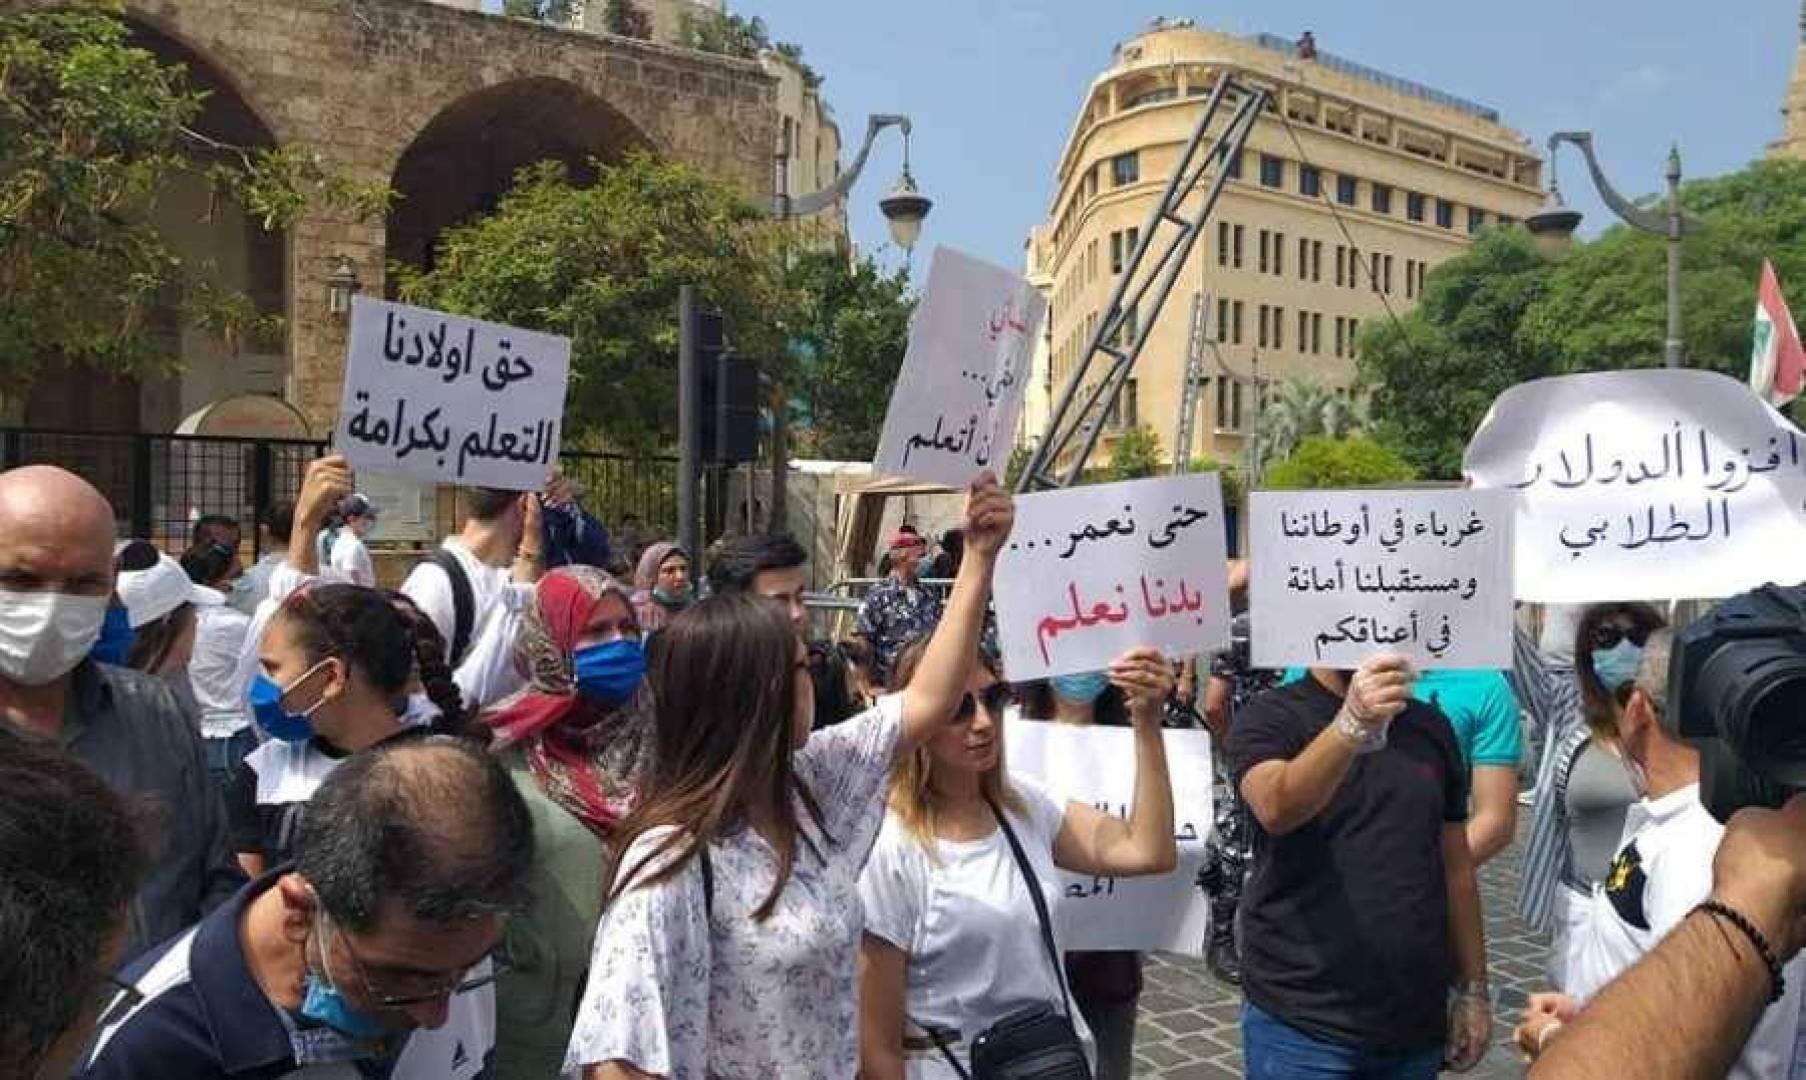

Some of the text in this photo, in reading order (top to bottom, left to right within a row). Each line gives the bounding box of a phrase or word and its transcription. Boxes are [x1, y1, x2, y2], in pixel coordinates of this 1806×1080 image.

[384, 311, 534, 391] حق اولادنا
[349, 391, 554, 477] التعلم بكرامة
[903, 415, 978, 467] أتعلم
[1148, 504, 1209, 549] حتى
[1281, 504, 1484, 552] غرباء في أوطاننا
[1287, 559, 1478, 602] ومستقبلنا أمانة
[1037, 574, 1203, 666] بدنا نعلم
[1314, 609, 1452, 660] في أعناقكم
